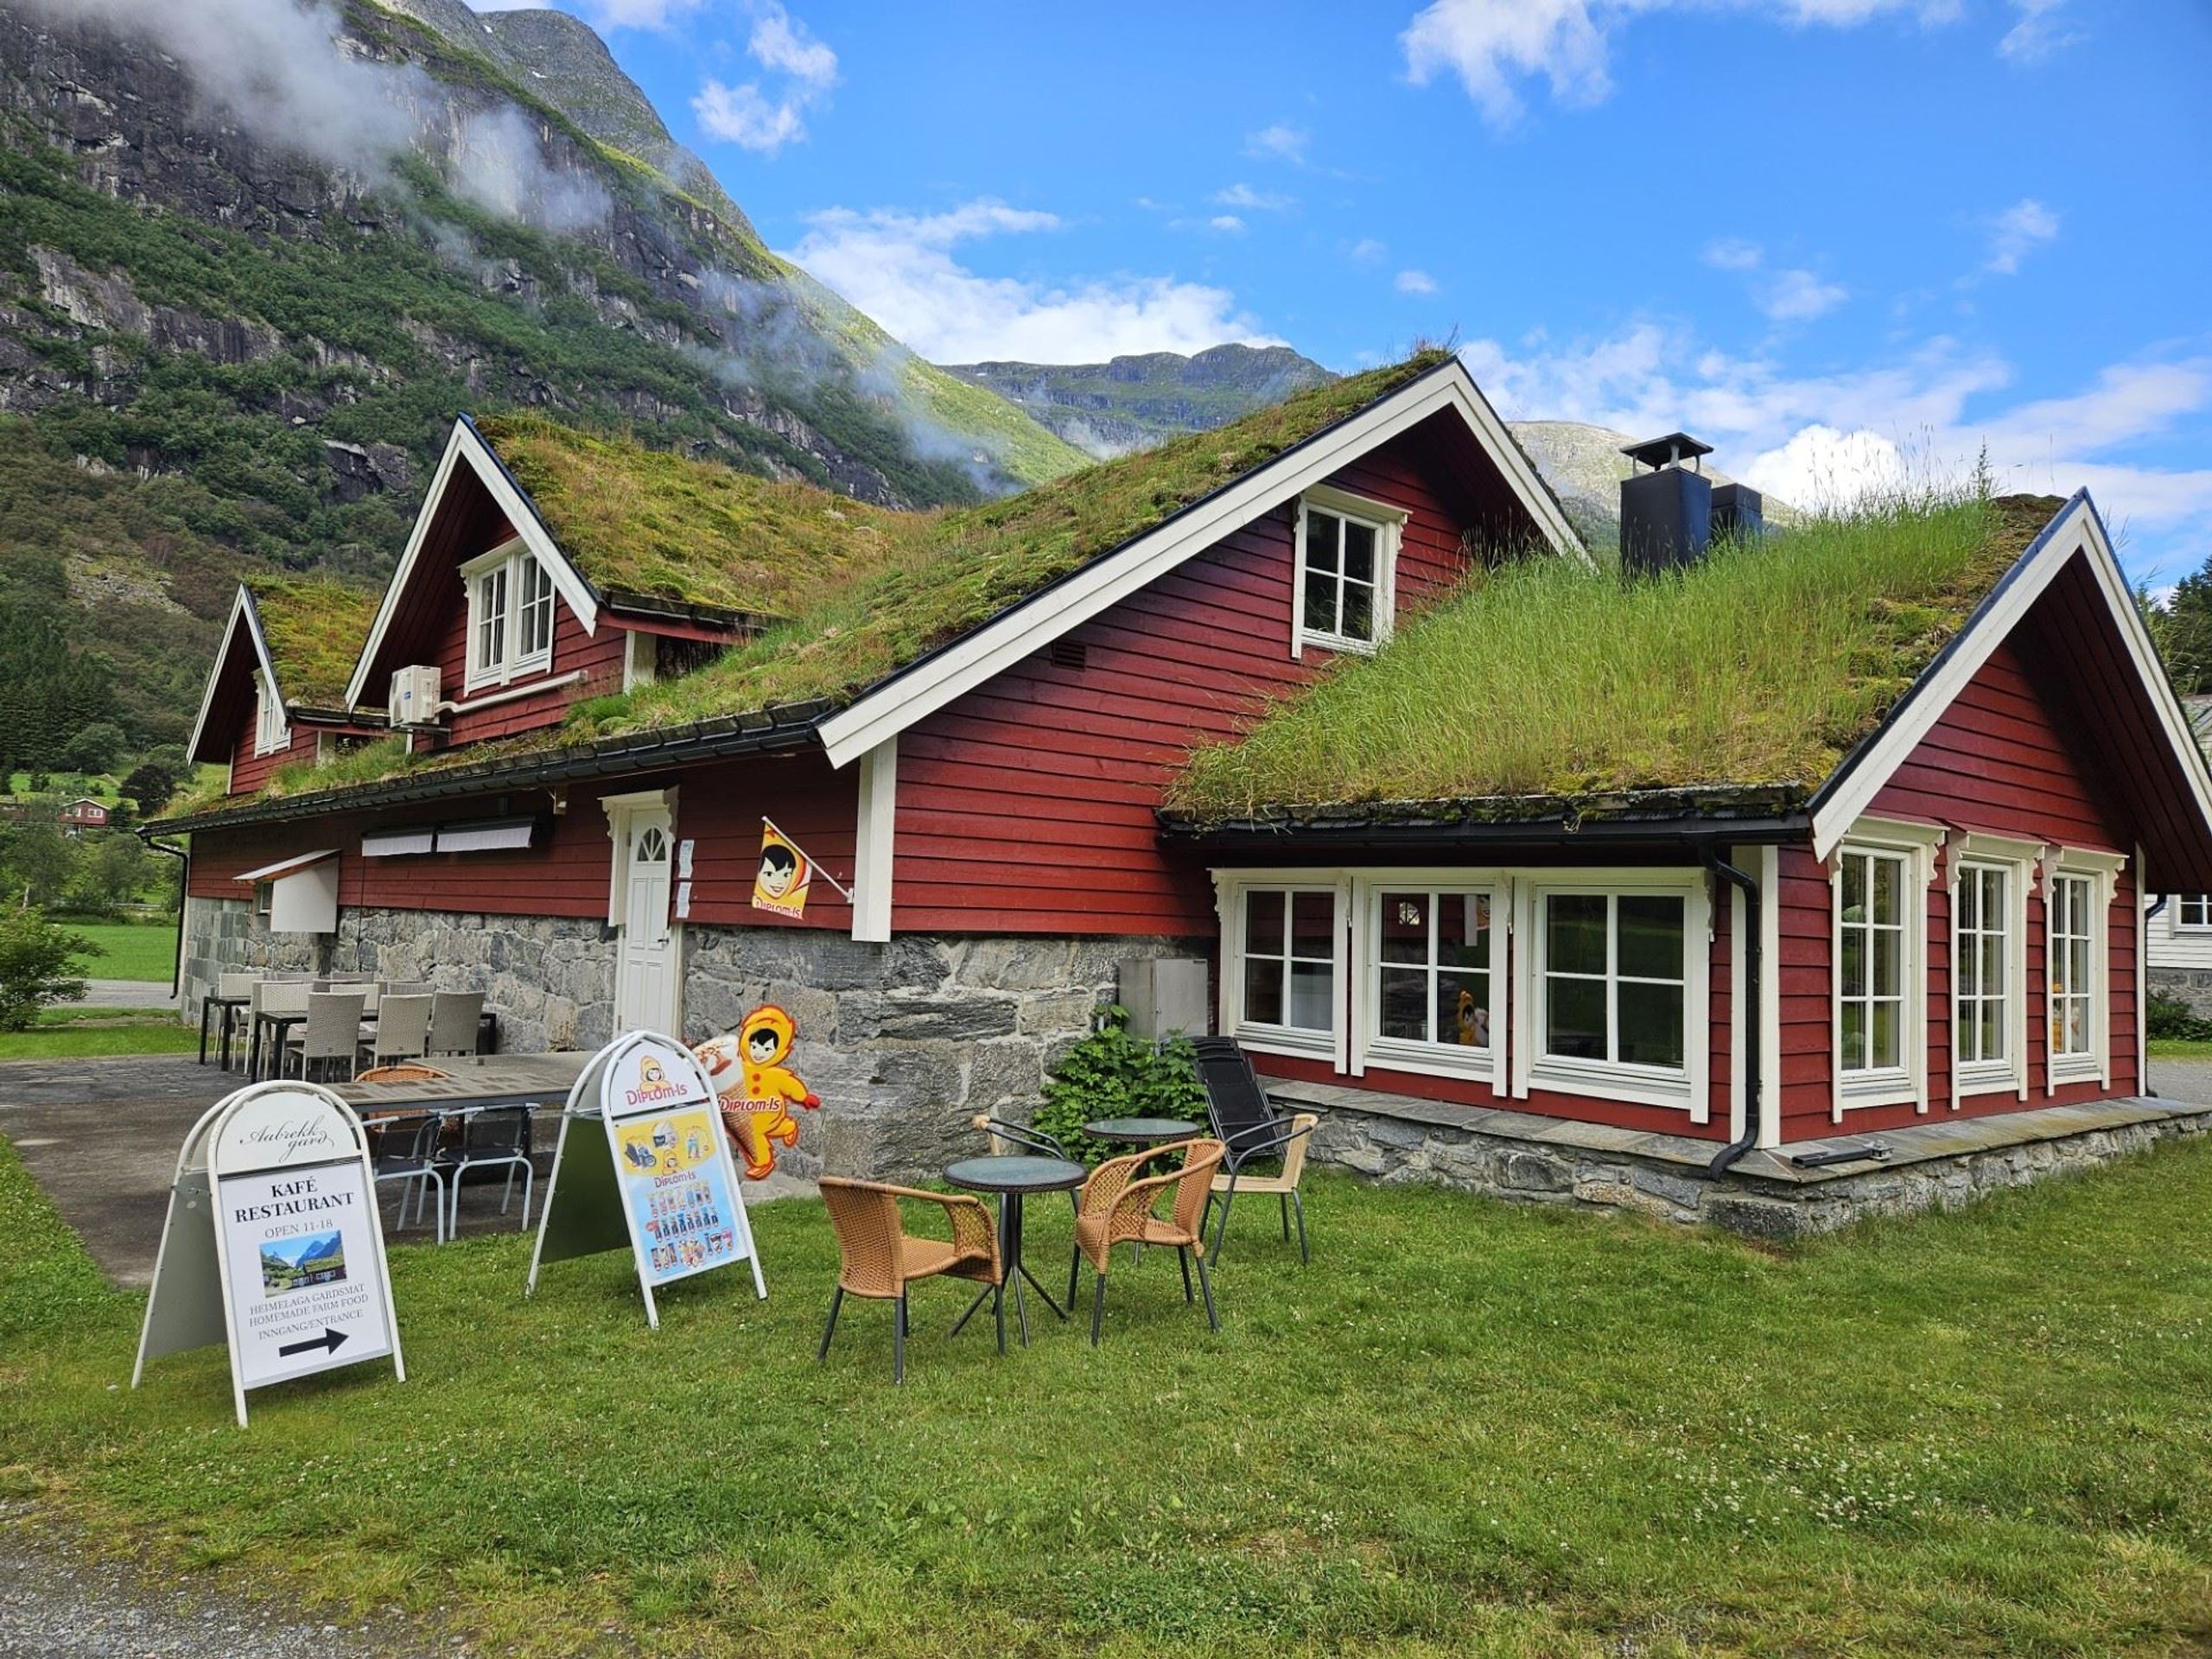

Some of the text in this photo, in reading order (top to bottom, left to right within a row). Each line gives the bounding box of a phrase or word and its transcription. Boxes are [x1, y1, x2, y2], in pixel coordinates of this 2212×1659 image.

[239, 1114, 325, 1143] Aabrekk
[278, 1129, 335, 1162] gard
[270, 1175, 318, 1198] KAFÉ
[235, 1192, 354, 1223] RESTAURANT
[264, 1218, 333, 1238] OPEN 11-18
[249, 1294, 369, 1327] HOMEMADE FARM FOOD
